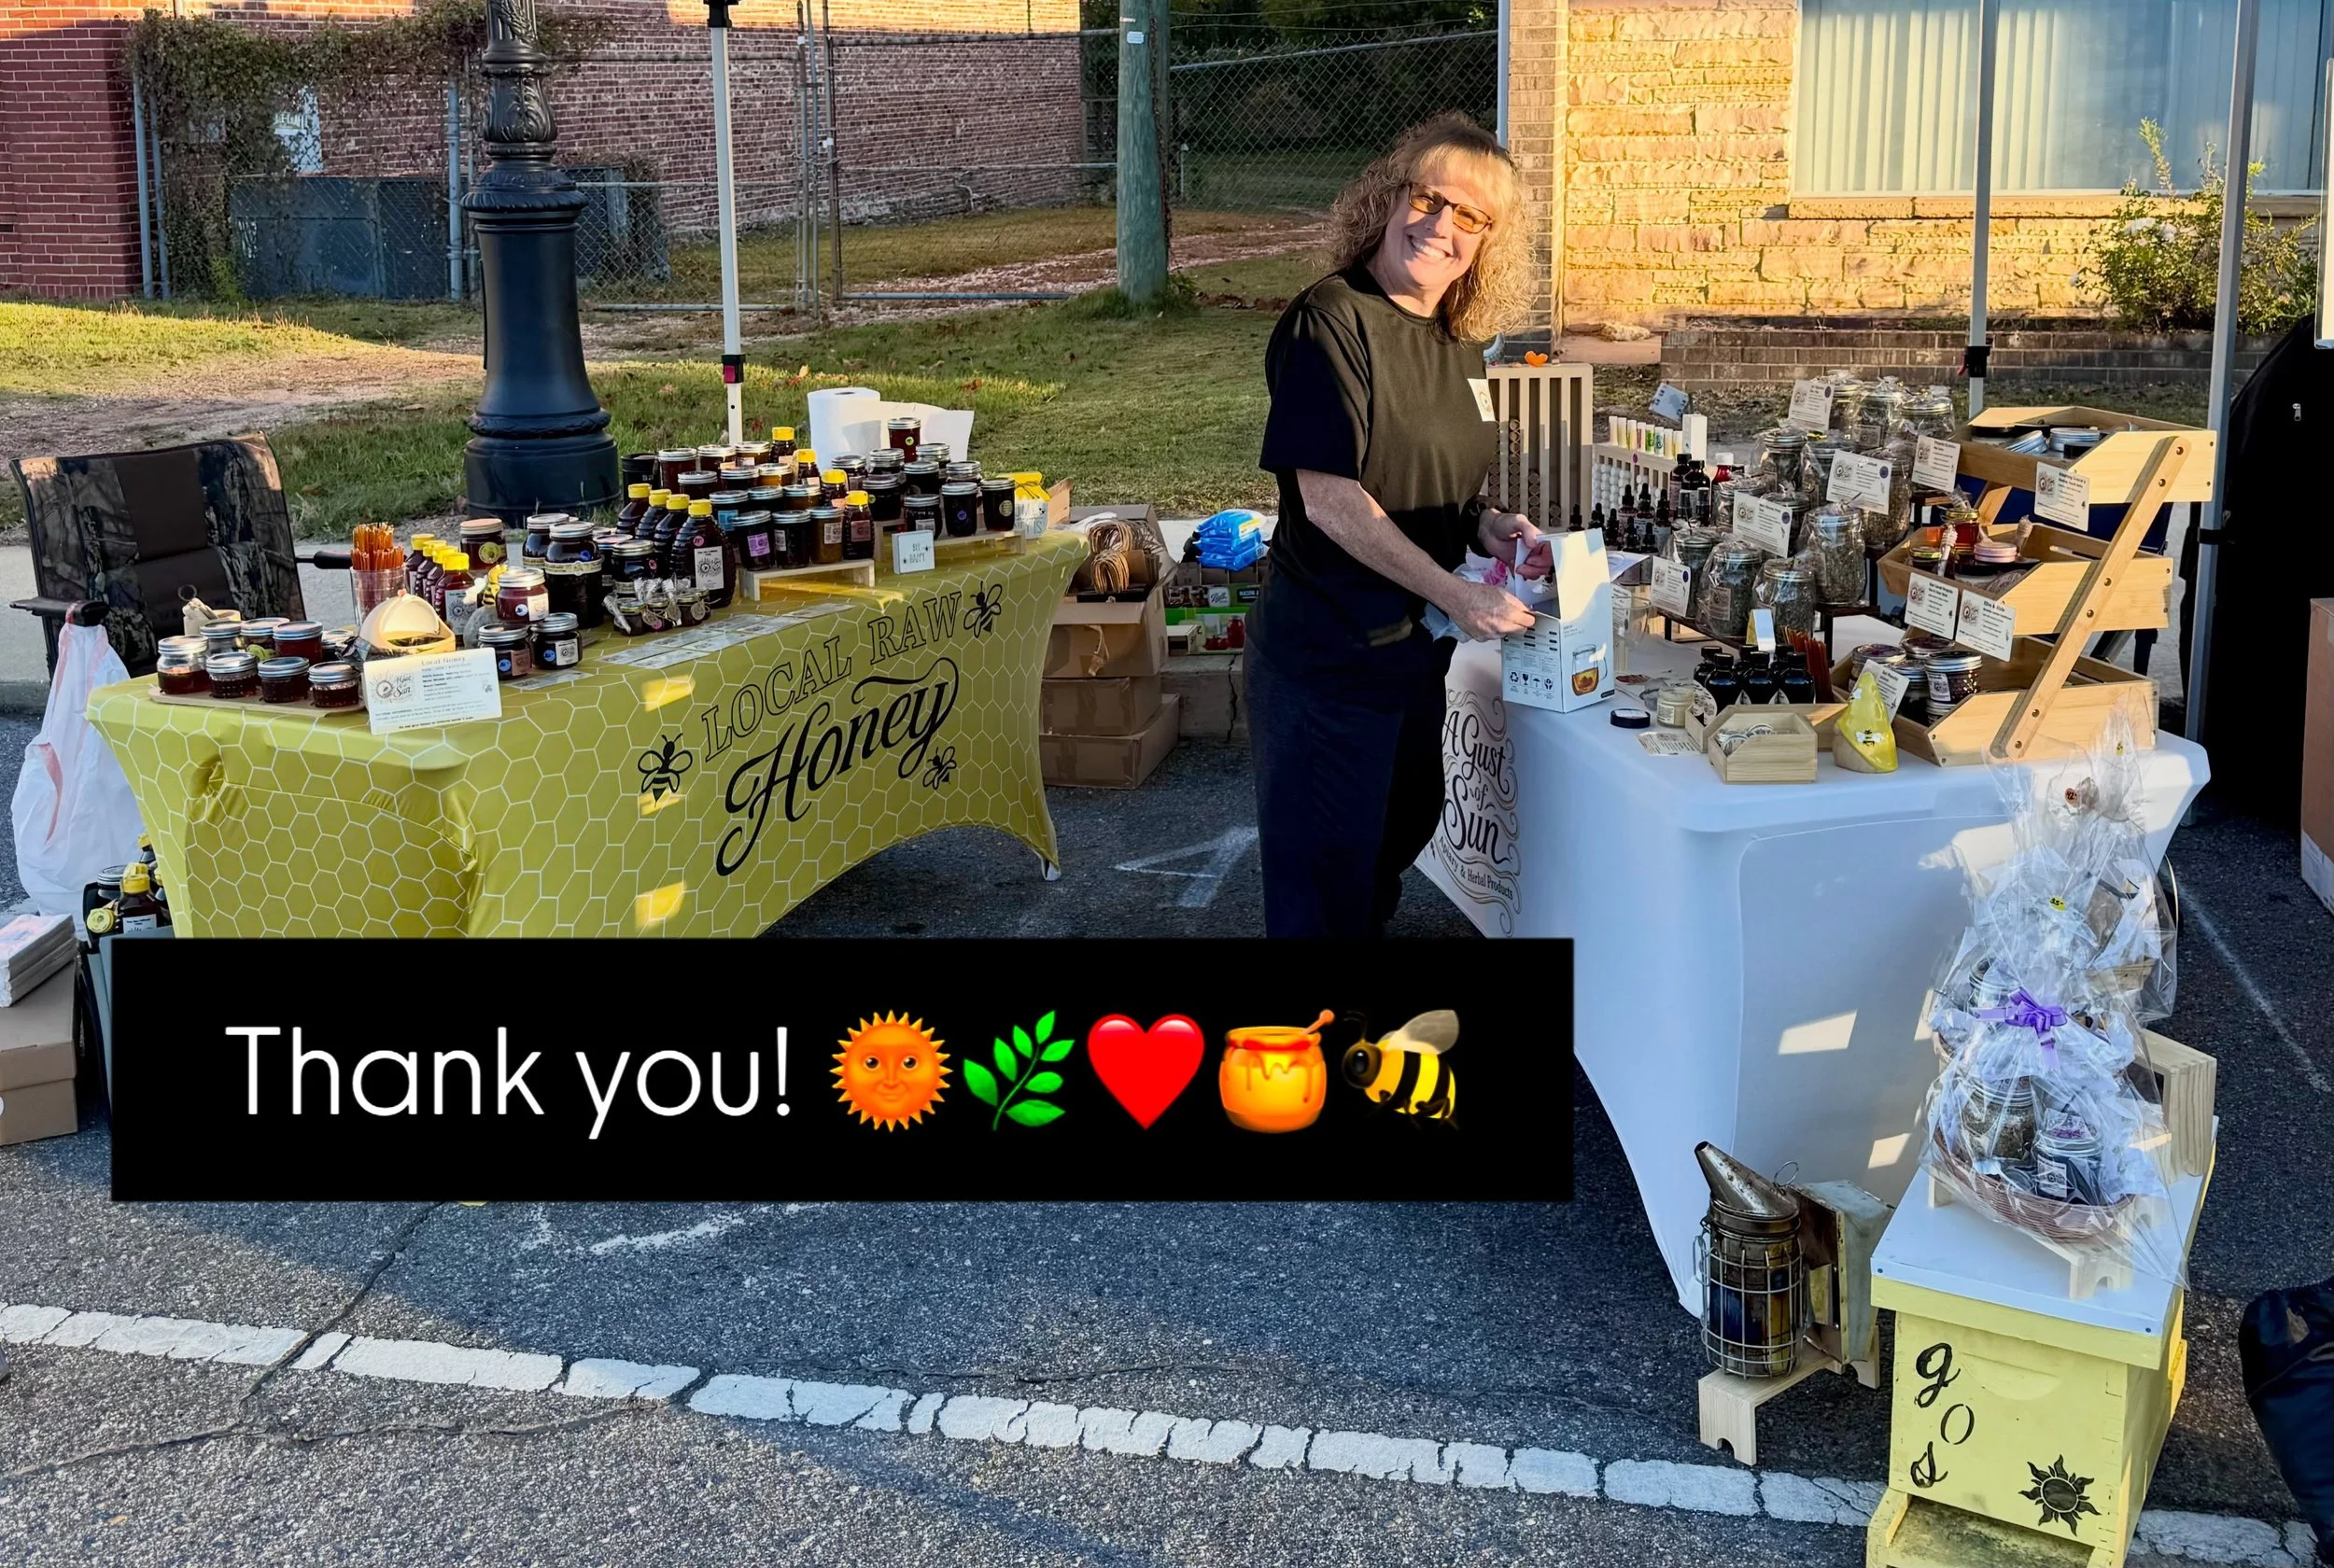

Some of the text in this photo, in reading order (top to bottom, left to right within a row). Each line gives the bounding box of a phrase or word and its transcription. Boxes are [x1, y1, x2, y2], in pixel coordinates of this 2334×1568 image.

[702, 592, 962, 762] LOCAL RAW
[716, 656, 960, 876] Honey
[1442, 710, 1510, 794] A Gust
[1442, 774, 1511, 864] Sun
[1467, 868, 1486, 888] Herbal
[1486, 875, 1513, 901] Products
